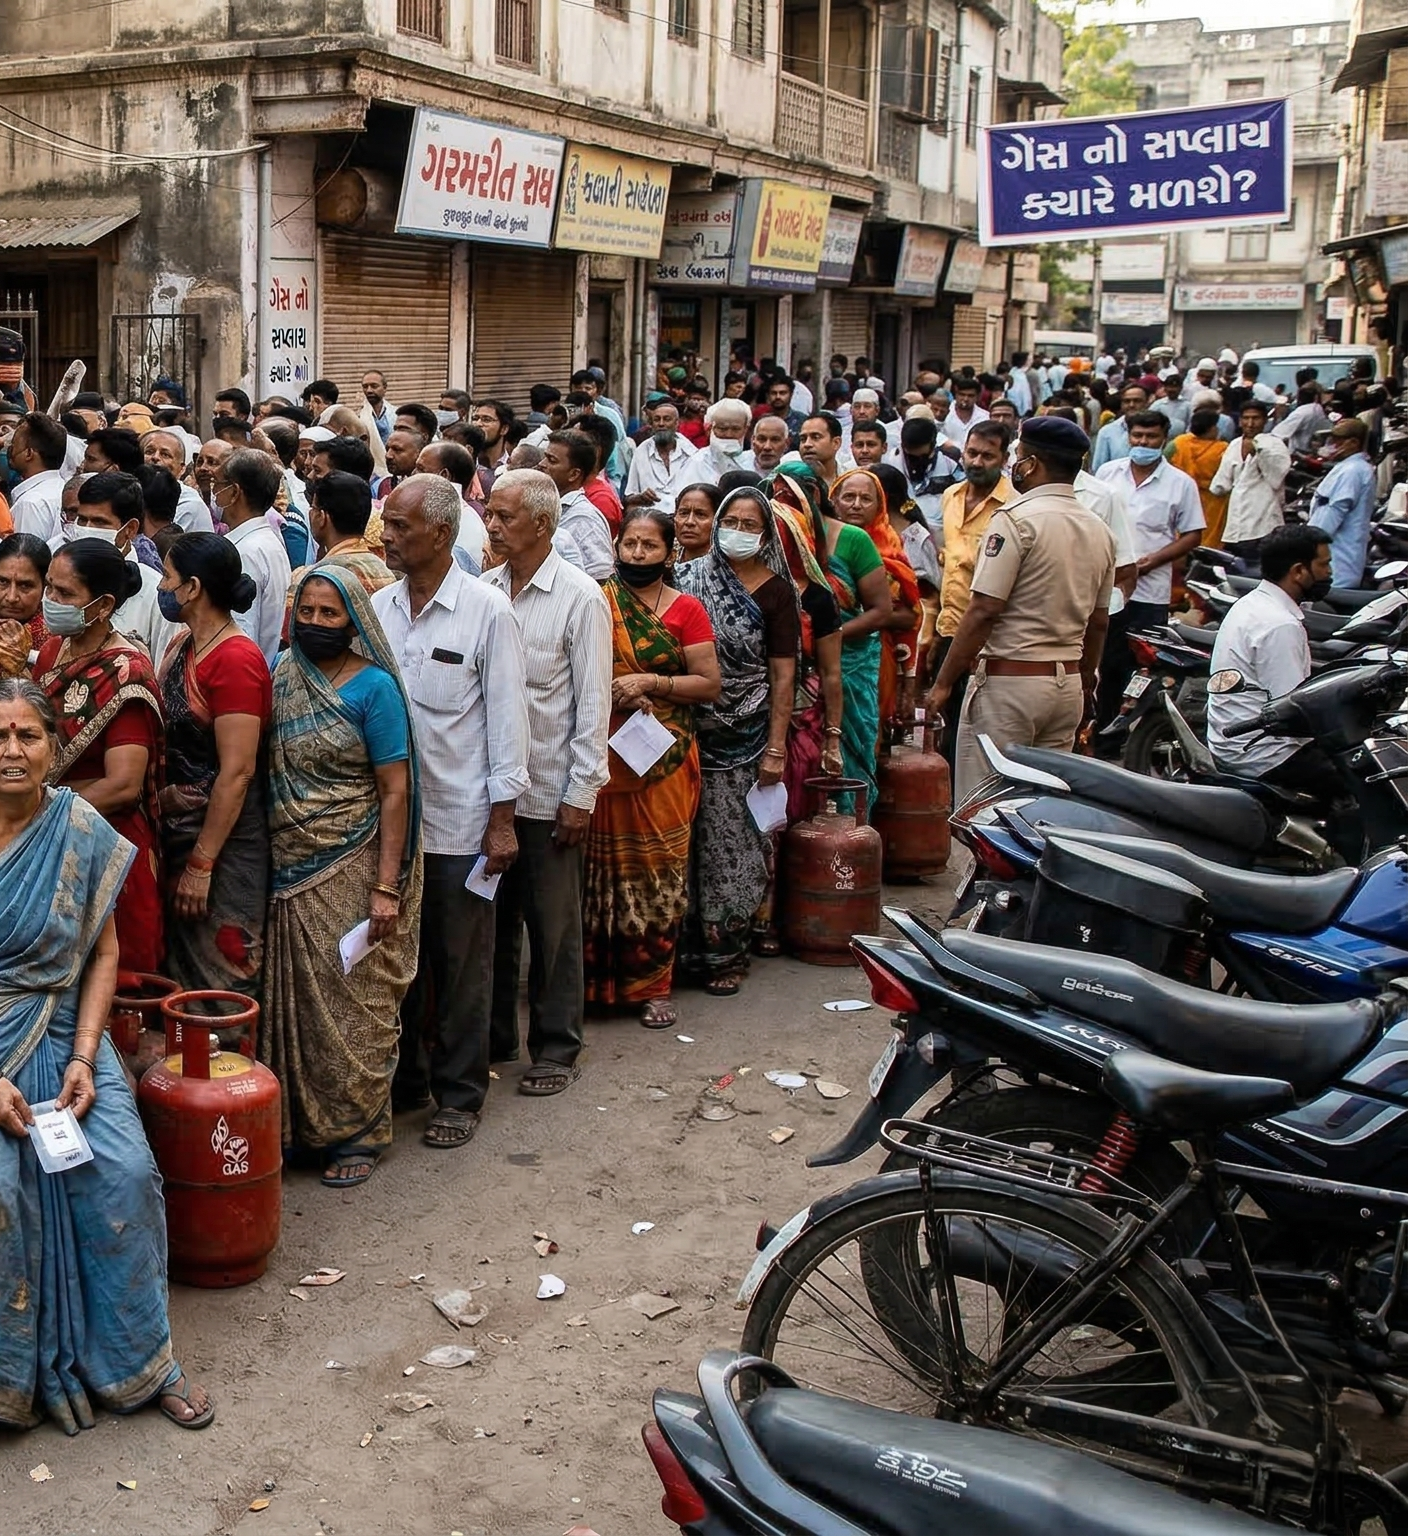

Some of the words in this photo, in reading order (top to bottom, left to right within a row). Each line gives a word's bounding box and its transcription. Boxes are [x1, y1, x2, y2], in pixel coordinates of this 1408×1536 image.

[1083, 123, 1128, 164] નો
[1142, 120, 1270, 160] સપ્લાય
[1022, 175, 1115, 220] ક્યારે
[1129, 164, 1257, 210] મળશે?
[295, 276, 308, 311] નો
